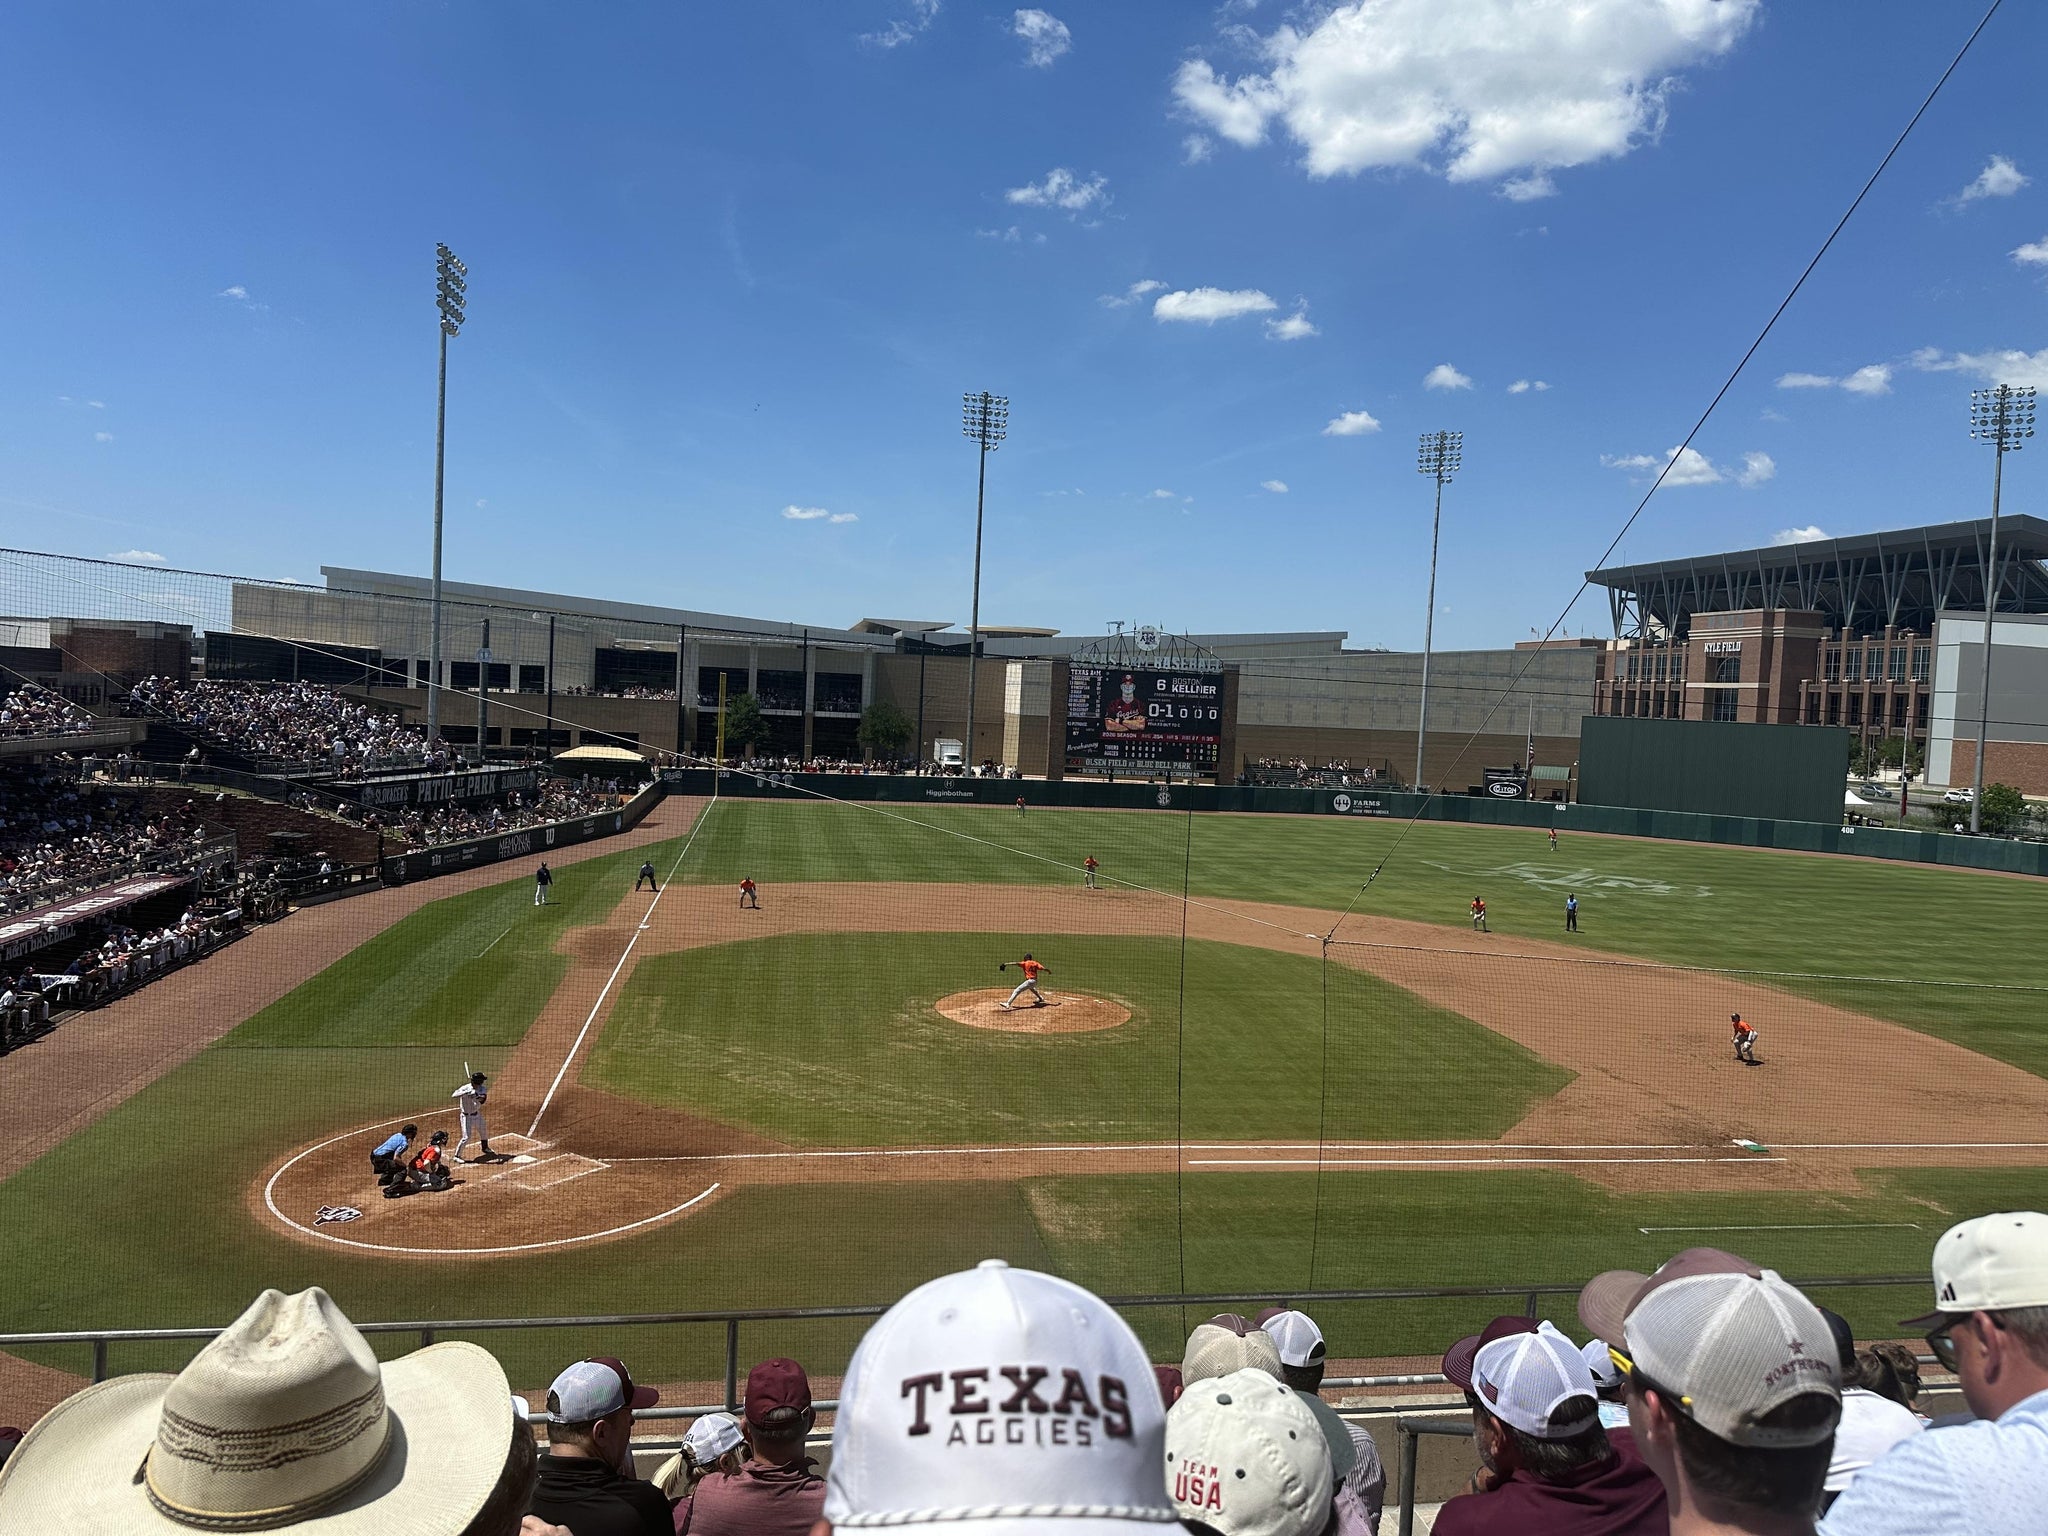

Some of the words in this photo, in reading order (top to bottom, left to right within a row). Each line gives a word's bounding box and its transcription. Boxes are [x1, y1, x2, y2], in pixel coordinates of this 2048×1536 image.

[1704, 642, 1721, 653] KYLE
[1722, 641, 1742, 652] FIELD
[1154, 656, 1224, 673] BASEBALL
[1157, 679, 1167, 691] 6
[1172, 677, 1202, 686] BOSTON
[1171, 684, 1217, 695] KELLNER
[1148, 703, 1174, 718] 0-1
[1180, 708, 1188, 719] 0
[1194, 709, 1203, 719] 0
[1209, 709, 1217, 720] 0
[1085, 758, 1107, 767] OLSEN
[1108, 759, 1127, 767] FIELD
[1136, 760, 1155, 769] BLUE
[1155, 761, 1172, 769] BELL
[1173, 761, 1192, 770] PARK
[455, 777, 465, 786] AT
[466, 773, 497, 797] PARK
[417, 778, 450, 803] PATIO
[454, 787, 465, 799] THE
[925, 789, 974, 798] Higginbotham
[1335, 798, 1350, 808] 44
[1353, 799, 1381, 807] FARMS
[1841, 826, 1855, 834] 400
[499, 832, 531, 850] MEMORIAL
[498, 841, 531, 860] HERMANN
[29, 925, 77, 952] BASEBALL
[901, 1365, 1133, 1440] TEXAS
[946, 1418, 1092, 1449] AGGIES
[1182, 1459, 1218, 1479] TEAM
[1175, 1471, 1222, 1511] USA
